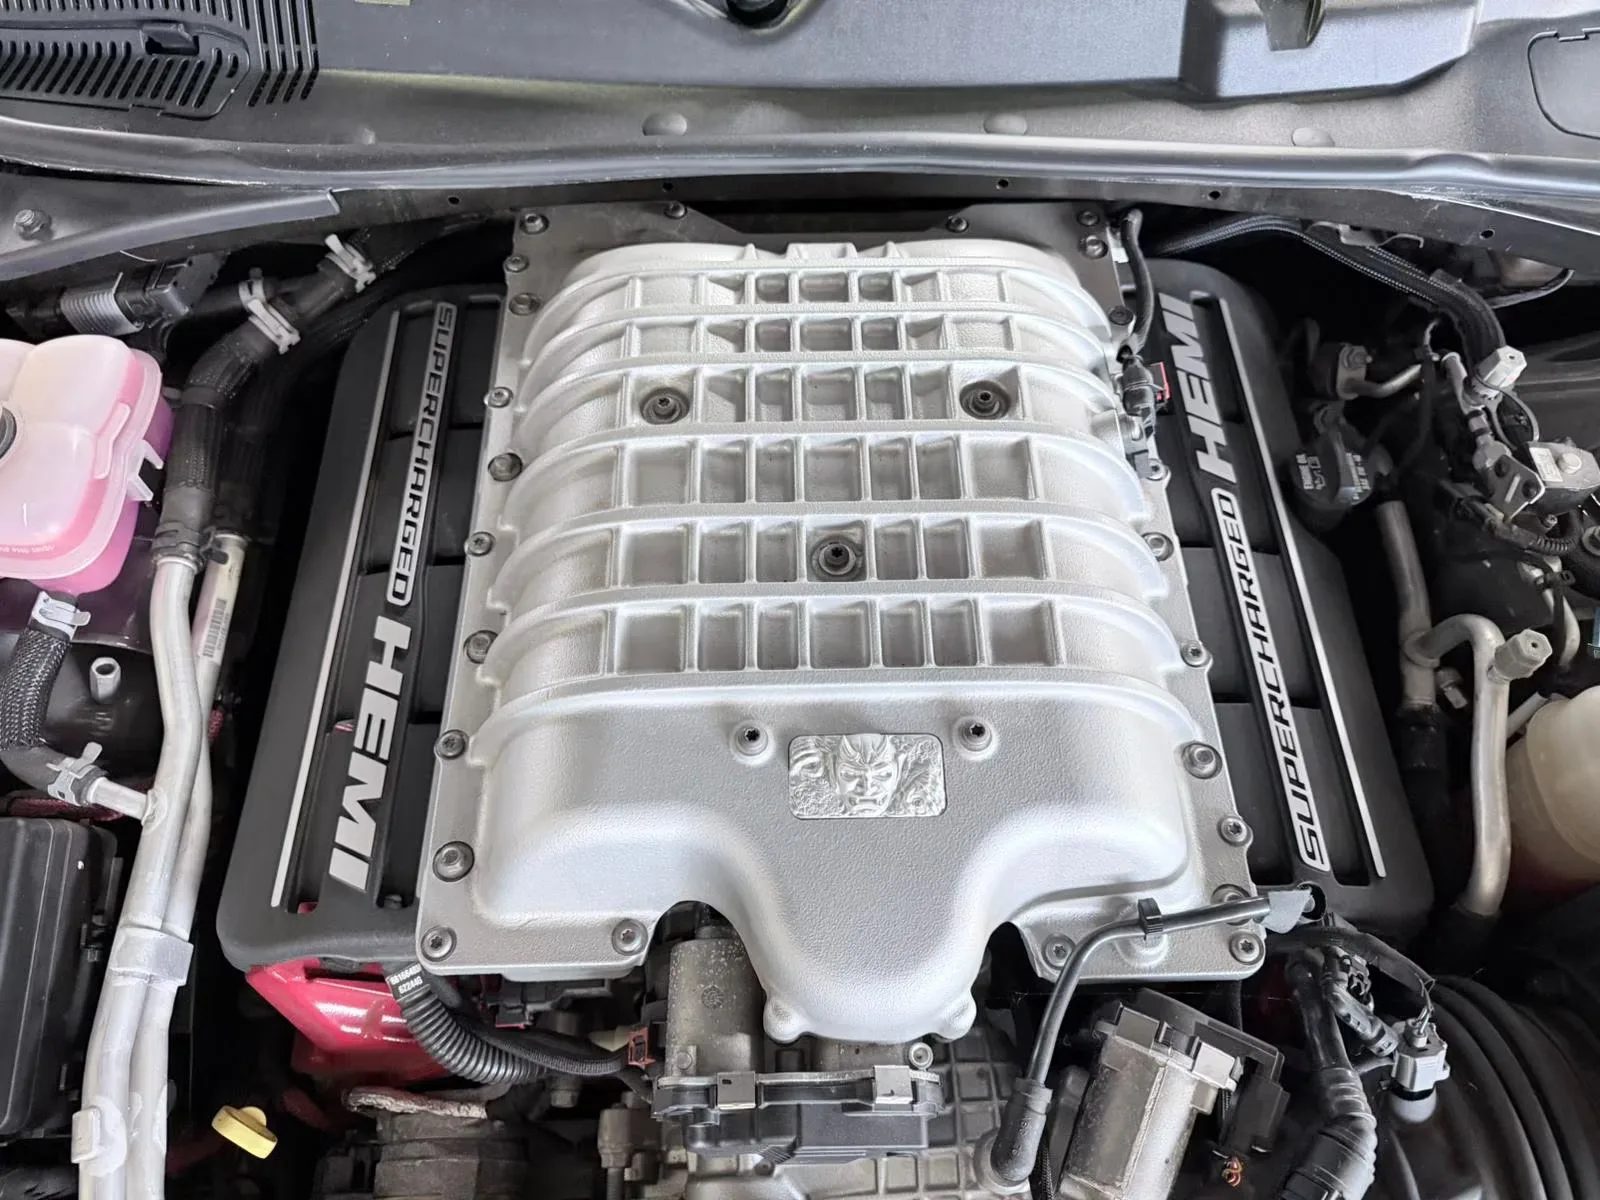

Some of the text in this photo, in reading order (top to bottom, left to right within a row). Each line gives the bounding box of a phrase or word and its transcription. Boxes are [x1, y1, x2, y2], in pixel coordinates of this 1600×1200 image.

[329, 303, 456, 893] SUPERCHARGED HEMI
[1158, 292, 1329, 870] SUPERCHARGED HEMI
